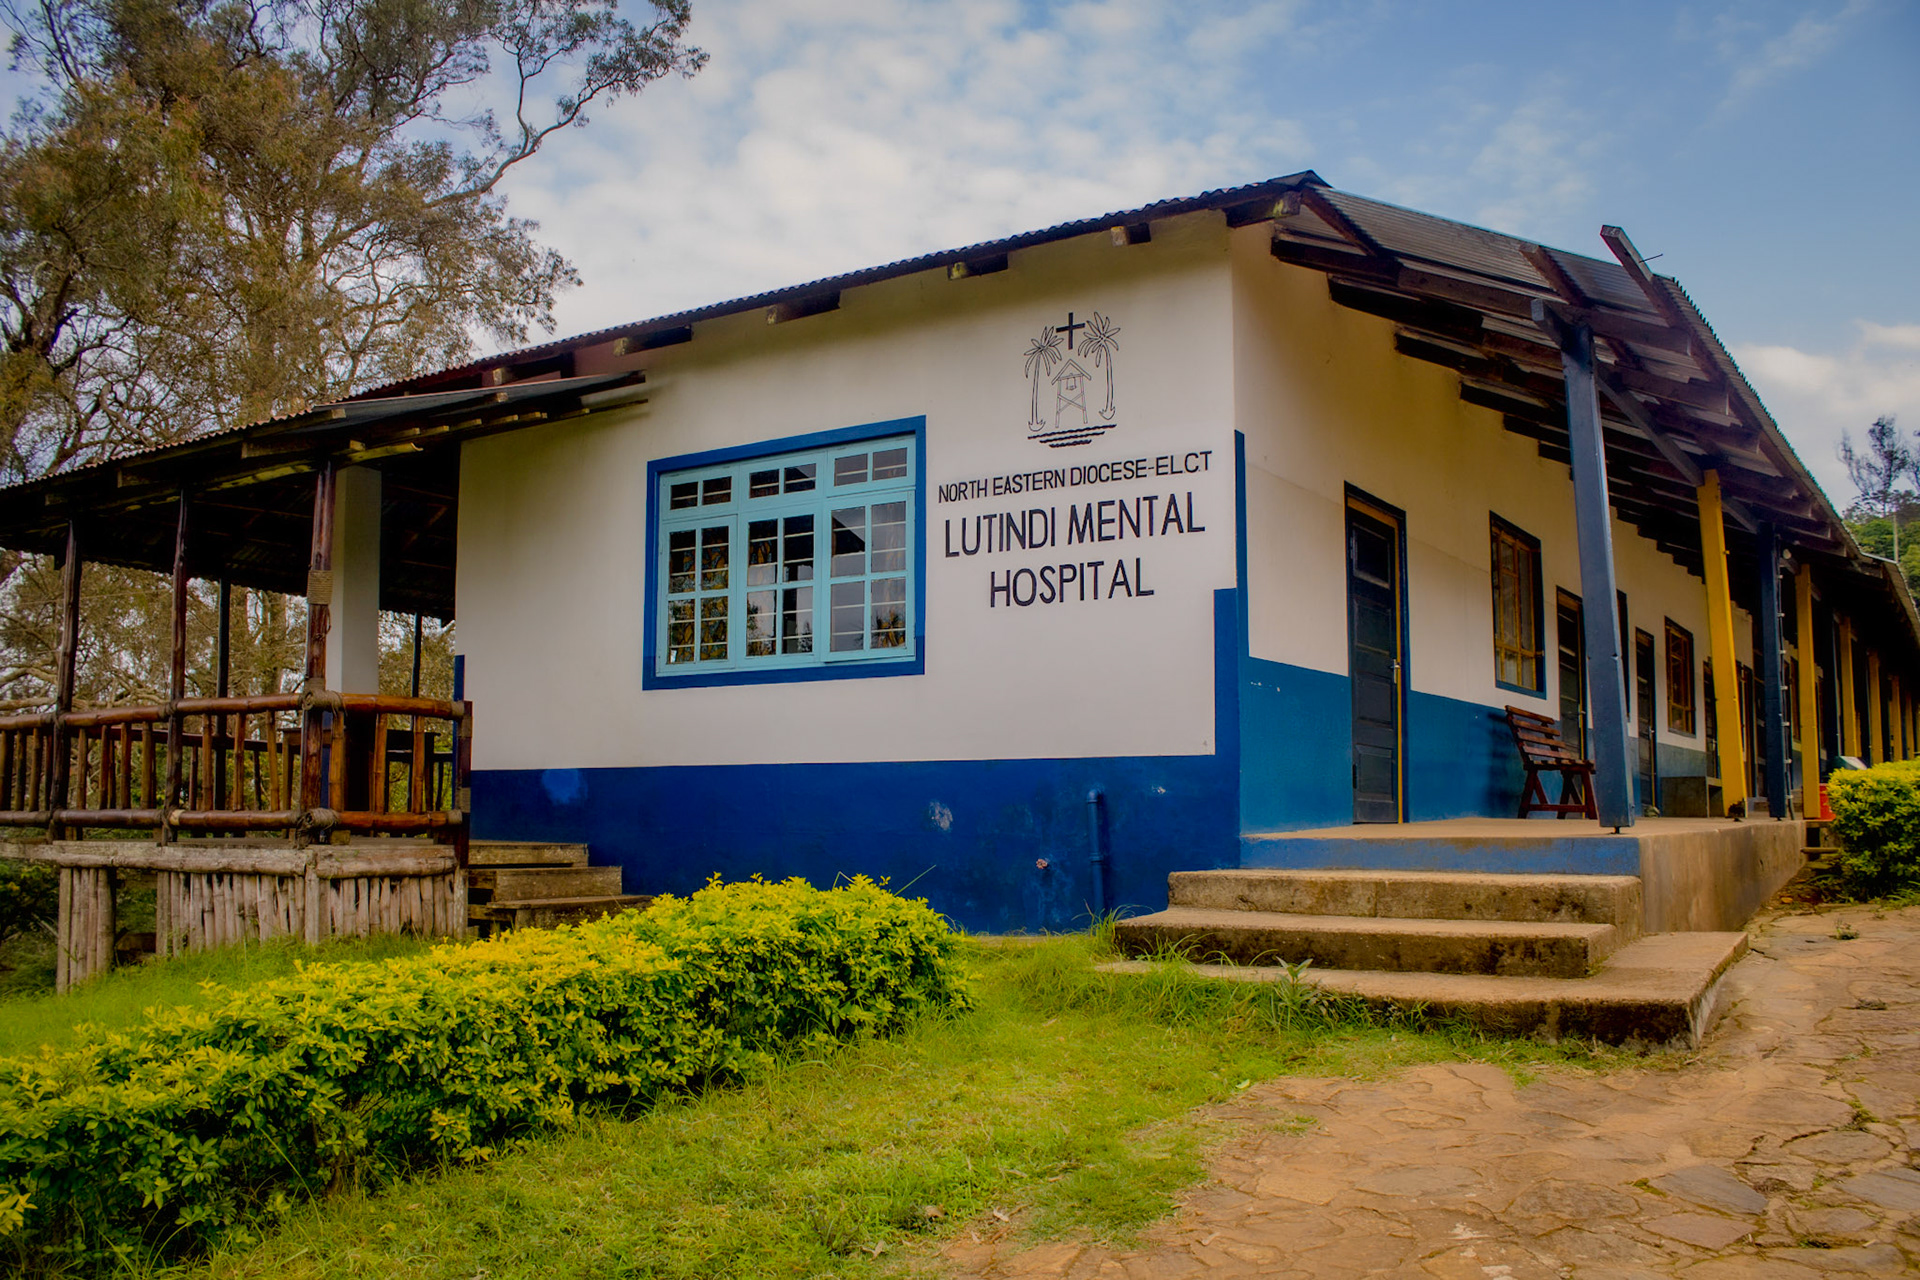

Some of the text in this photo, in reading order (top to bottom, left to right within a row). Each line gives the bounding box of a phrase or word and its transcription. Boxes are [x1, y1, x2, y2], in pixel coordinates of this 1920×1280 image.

[938, 478, 988, 504] NORTH
[992, 468, 1066, 497] EASTERN
[944, 491, 1206, 558] LUTINDI MENTAL
[990, 557, 1155, 608] HOSPITAL
